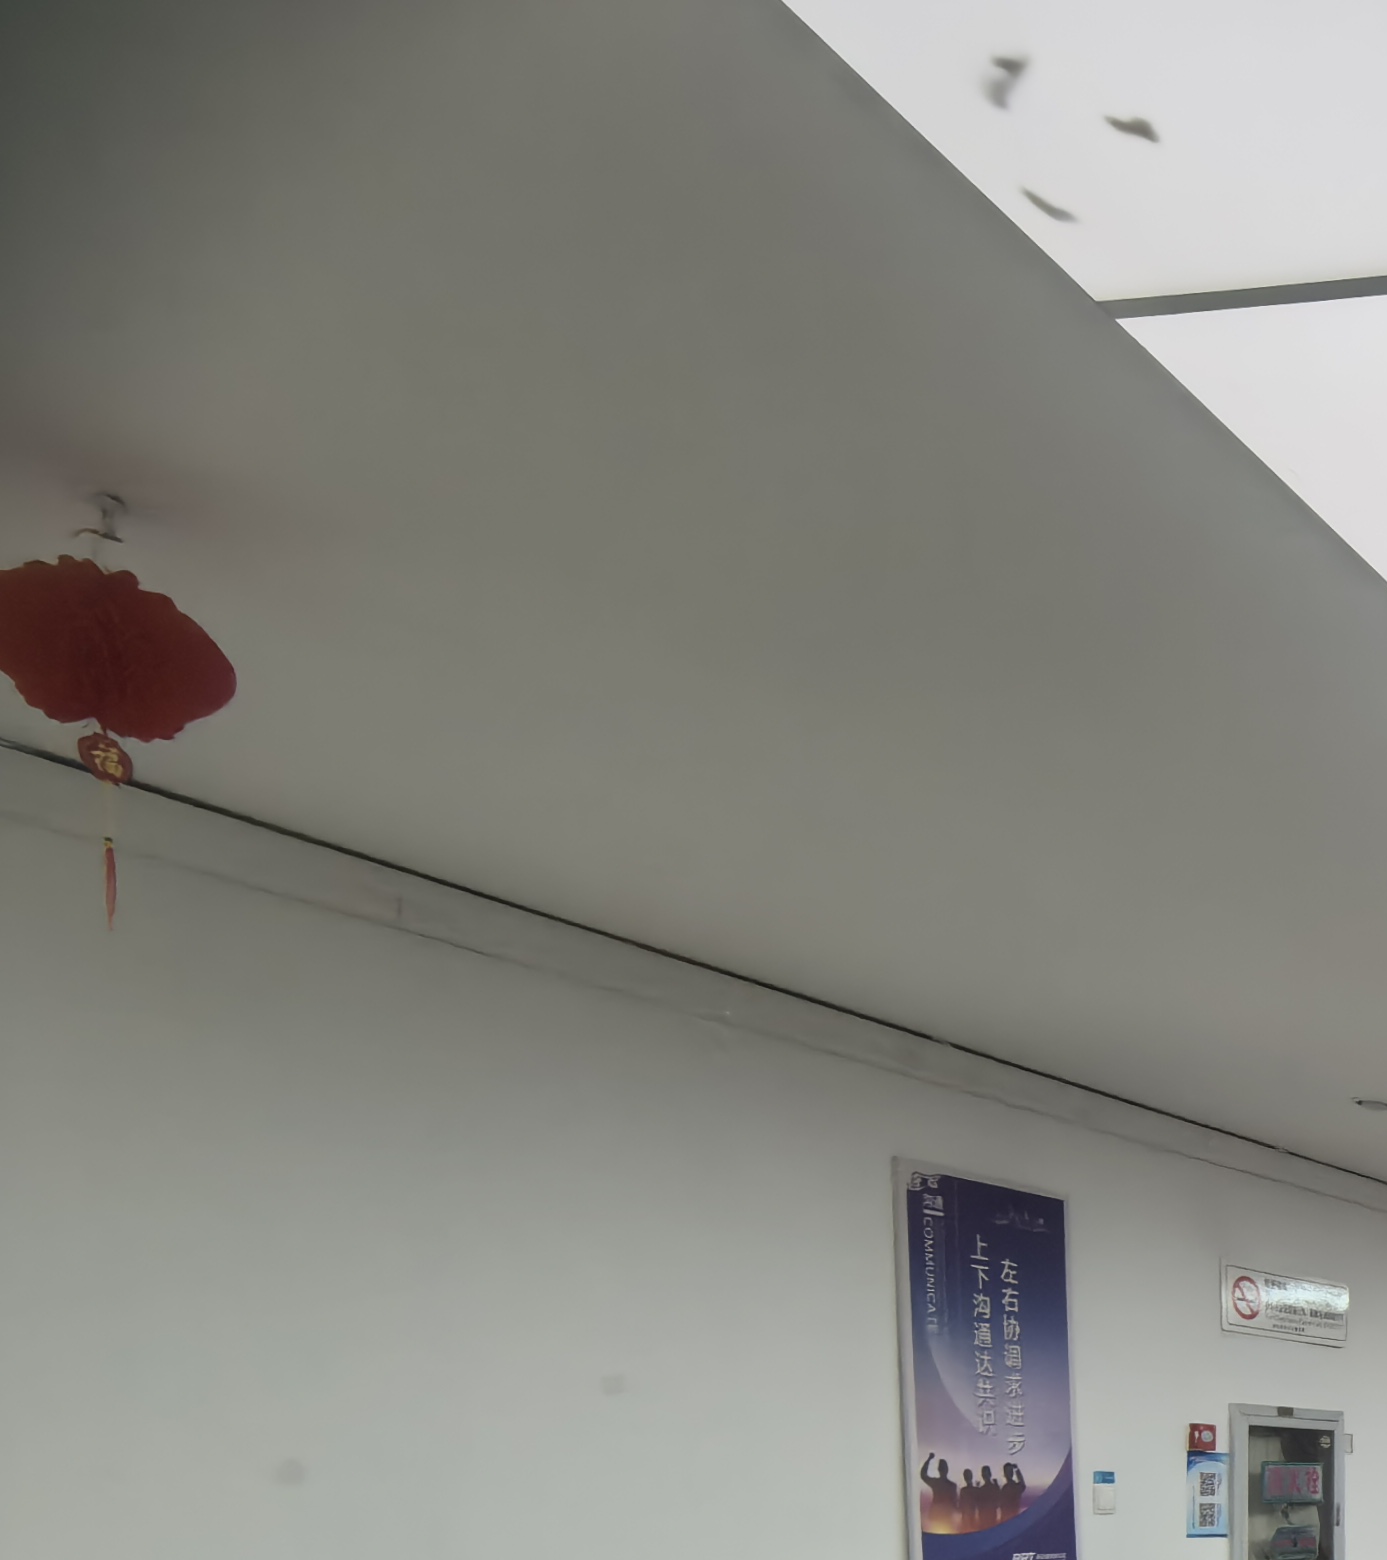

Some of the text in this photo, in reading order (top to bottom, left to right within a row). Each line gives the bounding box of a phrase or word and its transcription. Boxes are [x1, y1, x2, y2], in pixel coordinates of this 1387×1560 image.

[970, 1233, 997, 1436] 上下沟通达共识
[1001, 1259, 1025, 1455] 左右协调求进步
